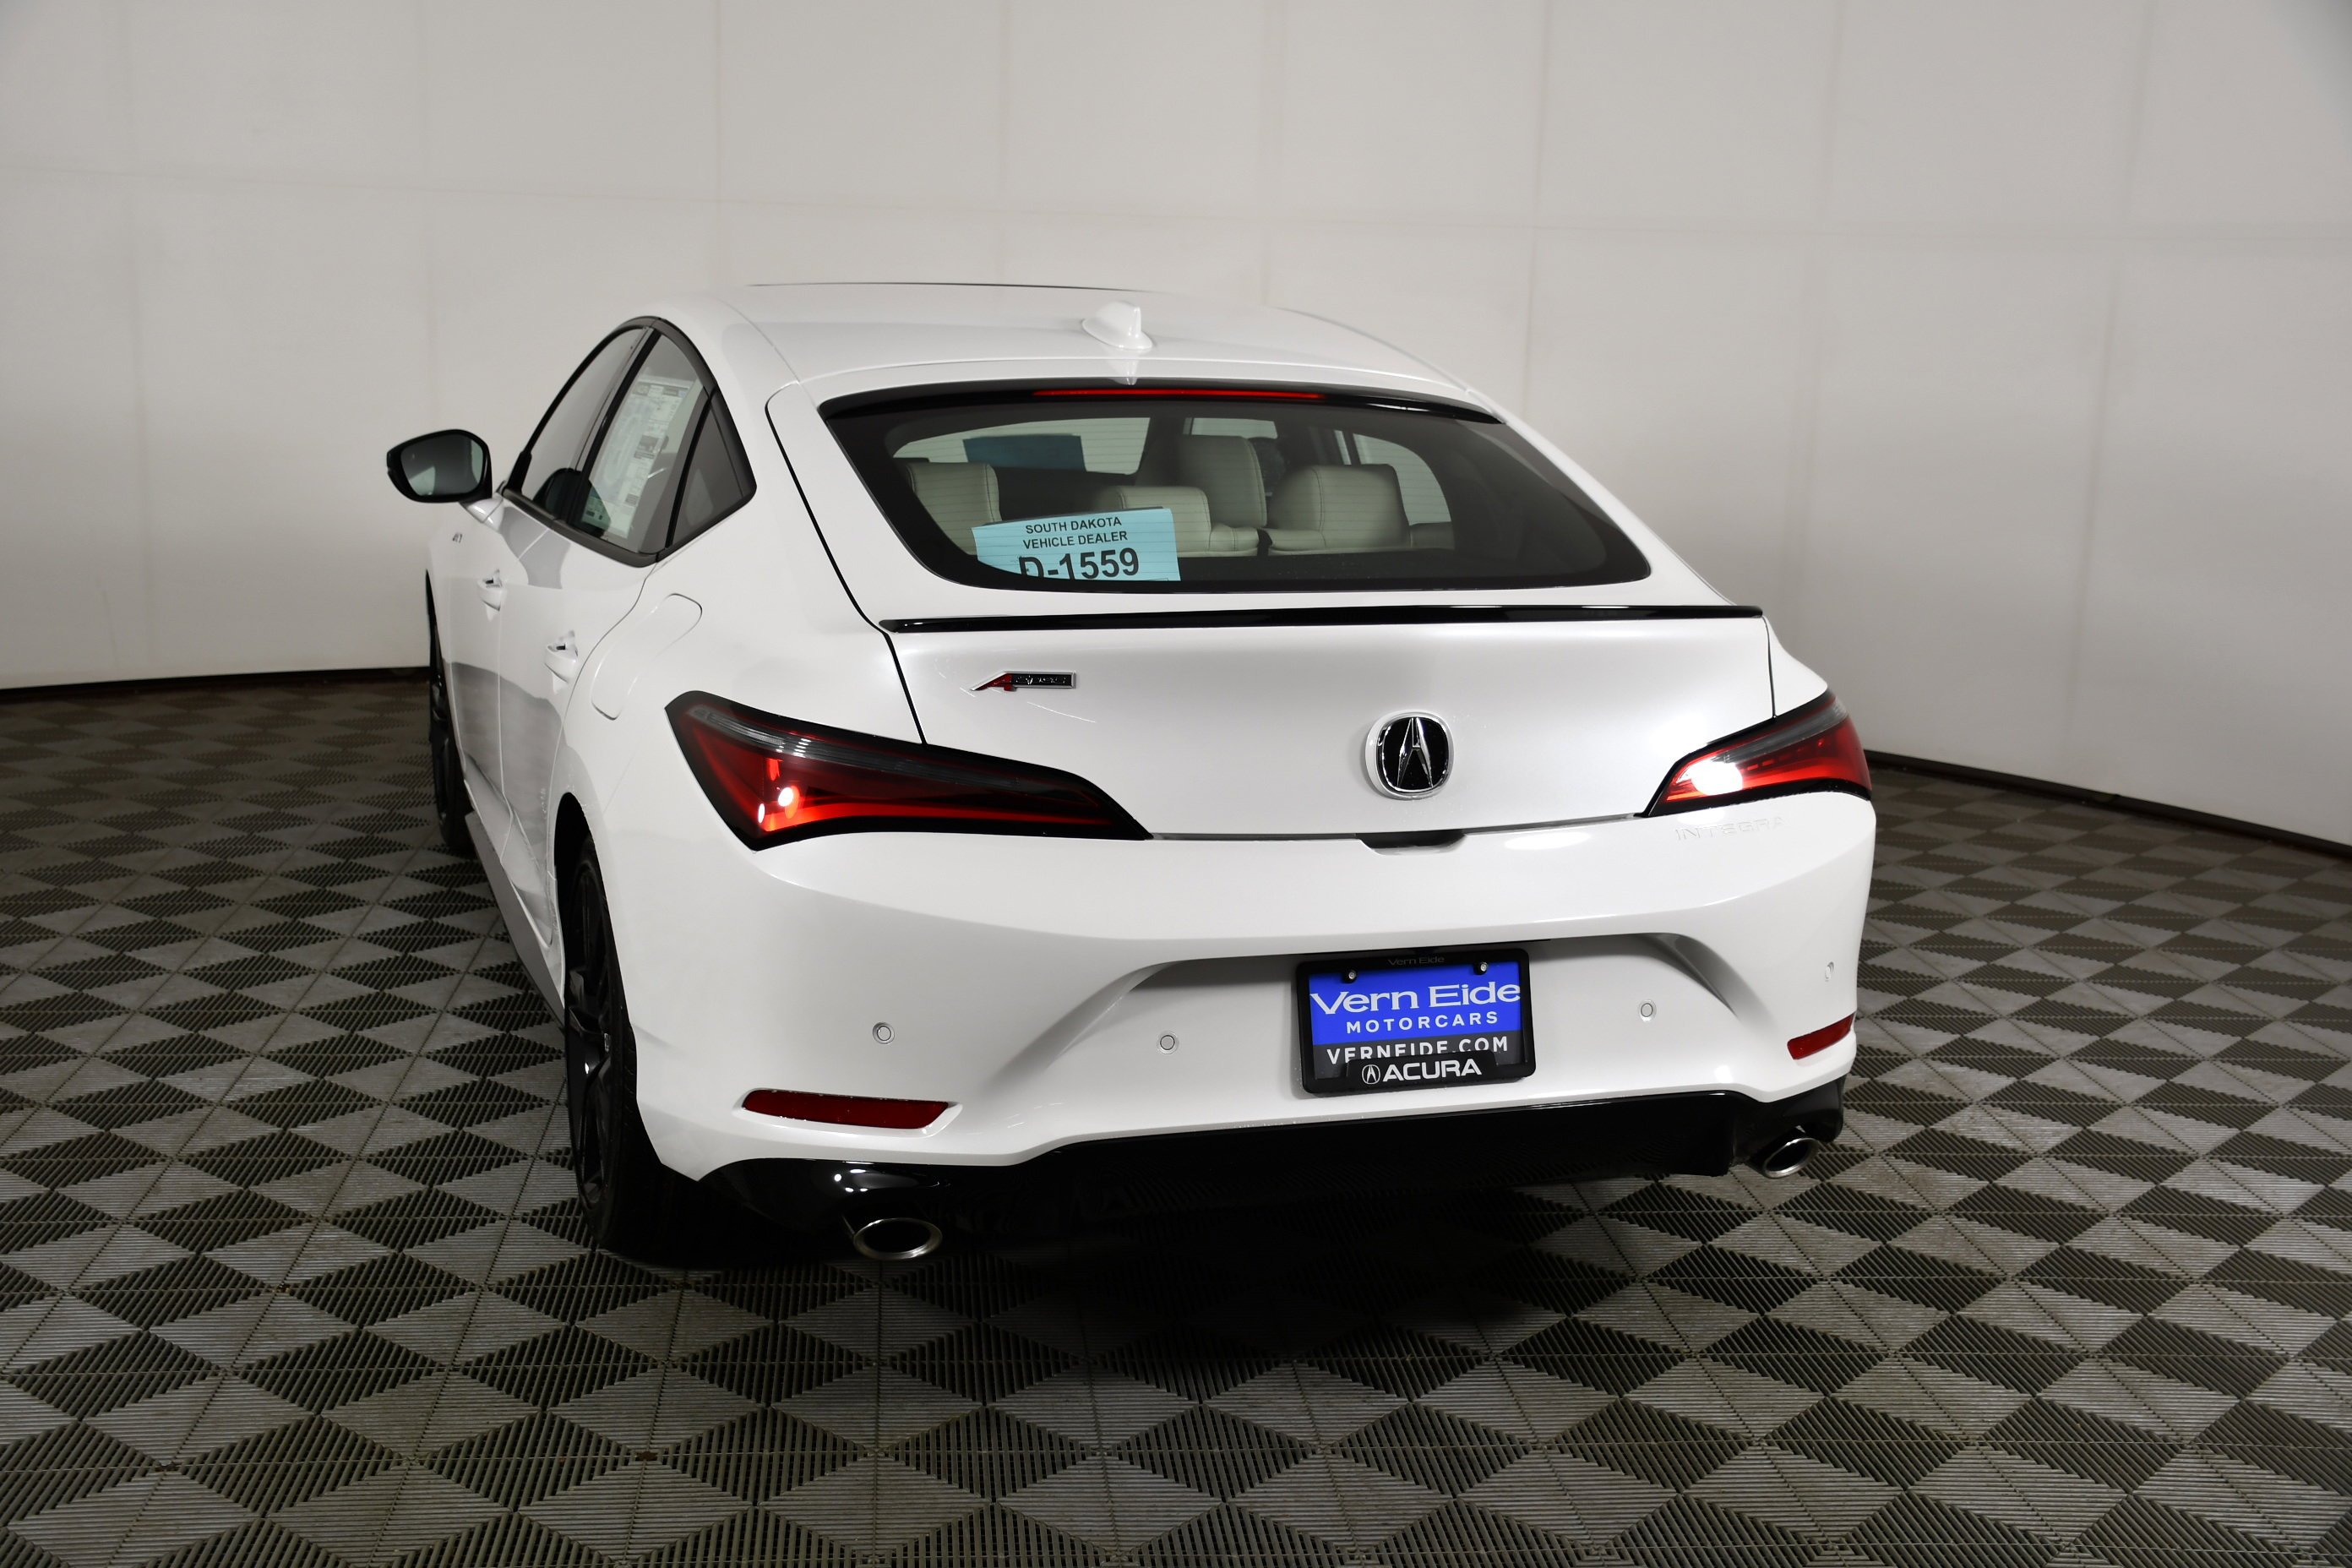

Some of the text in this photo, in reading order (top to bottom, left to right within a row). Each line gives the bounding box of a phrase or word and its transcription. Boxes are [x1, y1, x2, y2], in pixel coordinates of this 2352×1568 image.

[1026, 516, 1122, 534] SOUTH DAKOTA
[1023, 531, 1128, 549] VEHICLE DEALER
[1019, 547, 1140, 580] D-1559
[1674, 816, 1787, 841] INTEGRA
[1419, 956, 1445, 964] Eide
[1310, 981, 1521, 1015] Vern Eide
[1347, 1011, 1499, 1034] MOTORCARS
[1383, 1058, 1483, 1082] ACURA
